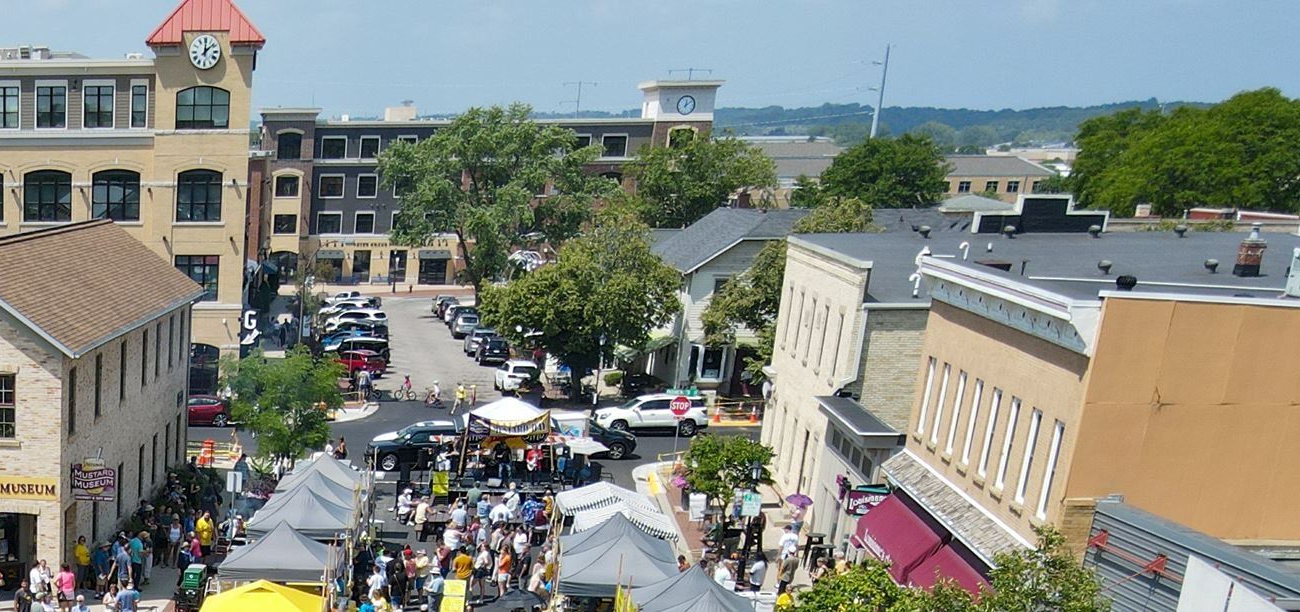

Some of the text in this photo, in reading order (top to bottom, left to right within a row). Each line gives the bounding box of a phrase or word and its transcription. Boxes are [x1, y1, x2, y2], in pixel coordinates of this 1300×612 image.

[244, 310, 257, 330] G
[672, 401, 690, 410] STOP
[74, 469, 114, 479] MUSTARD
[74, 479, 114, 489] MUSEUM
[0, 483, 56, 496] MUSEUM
